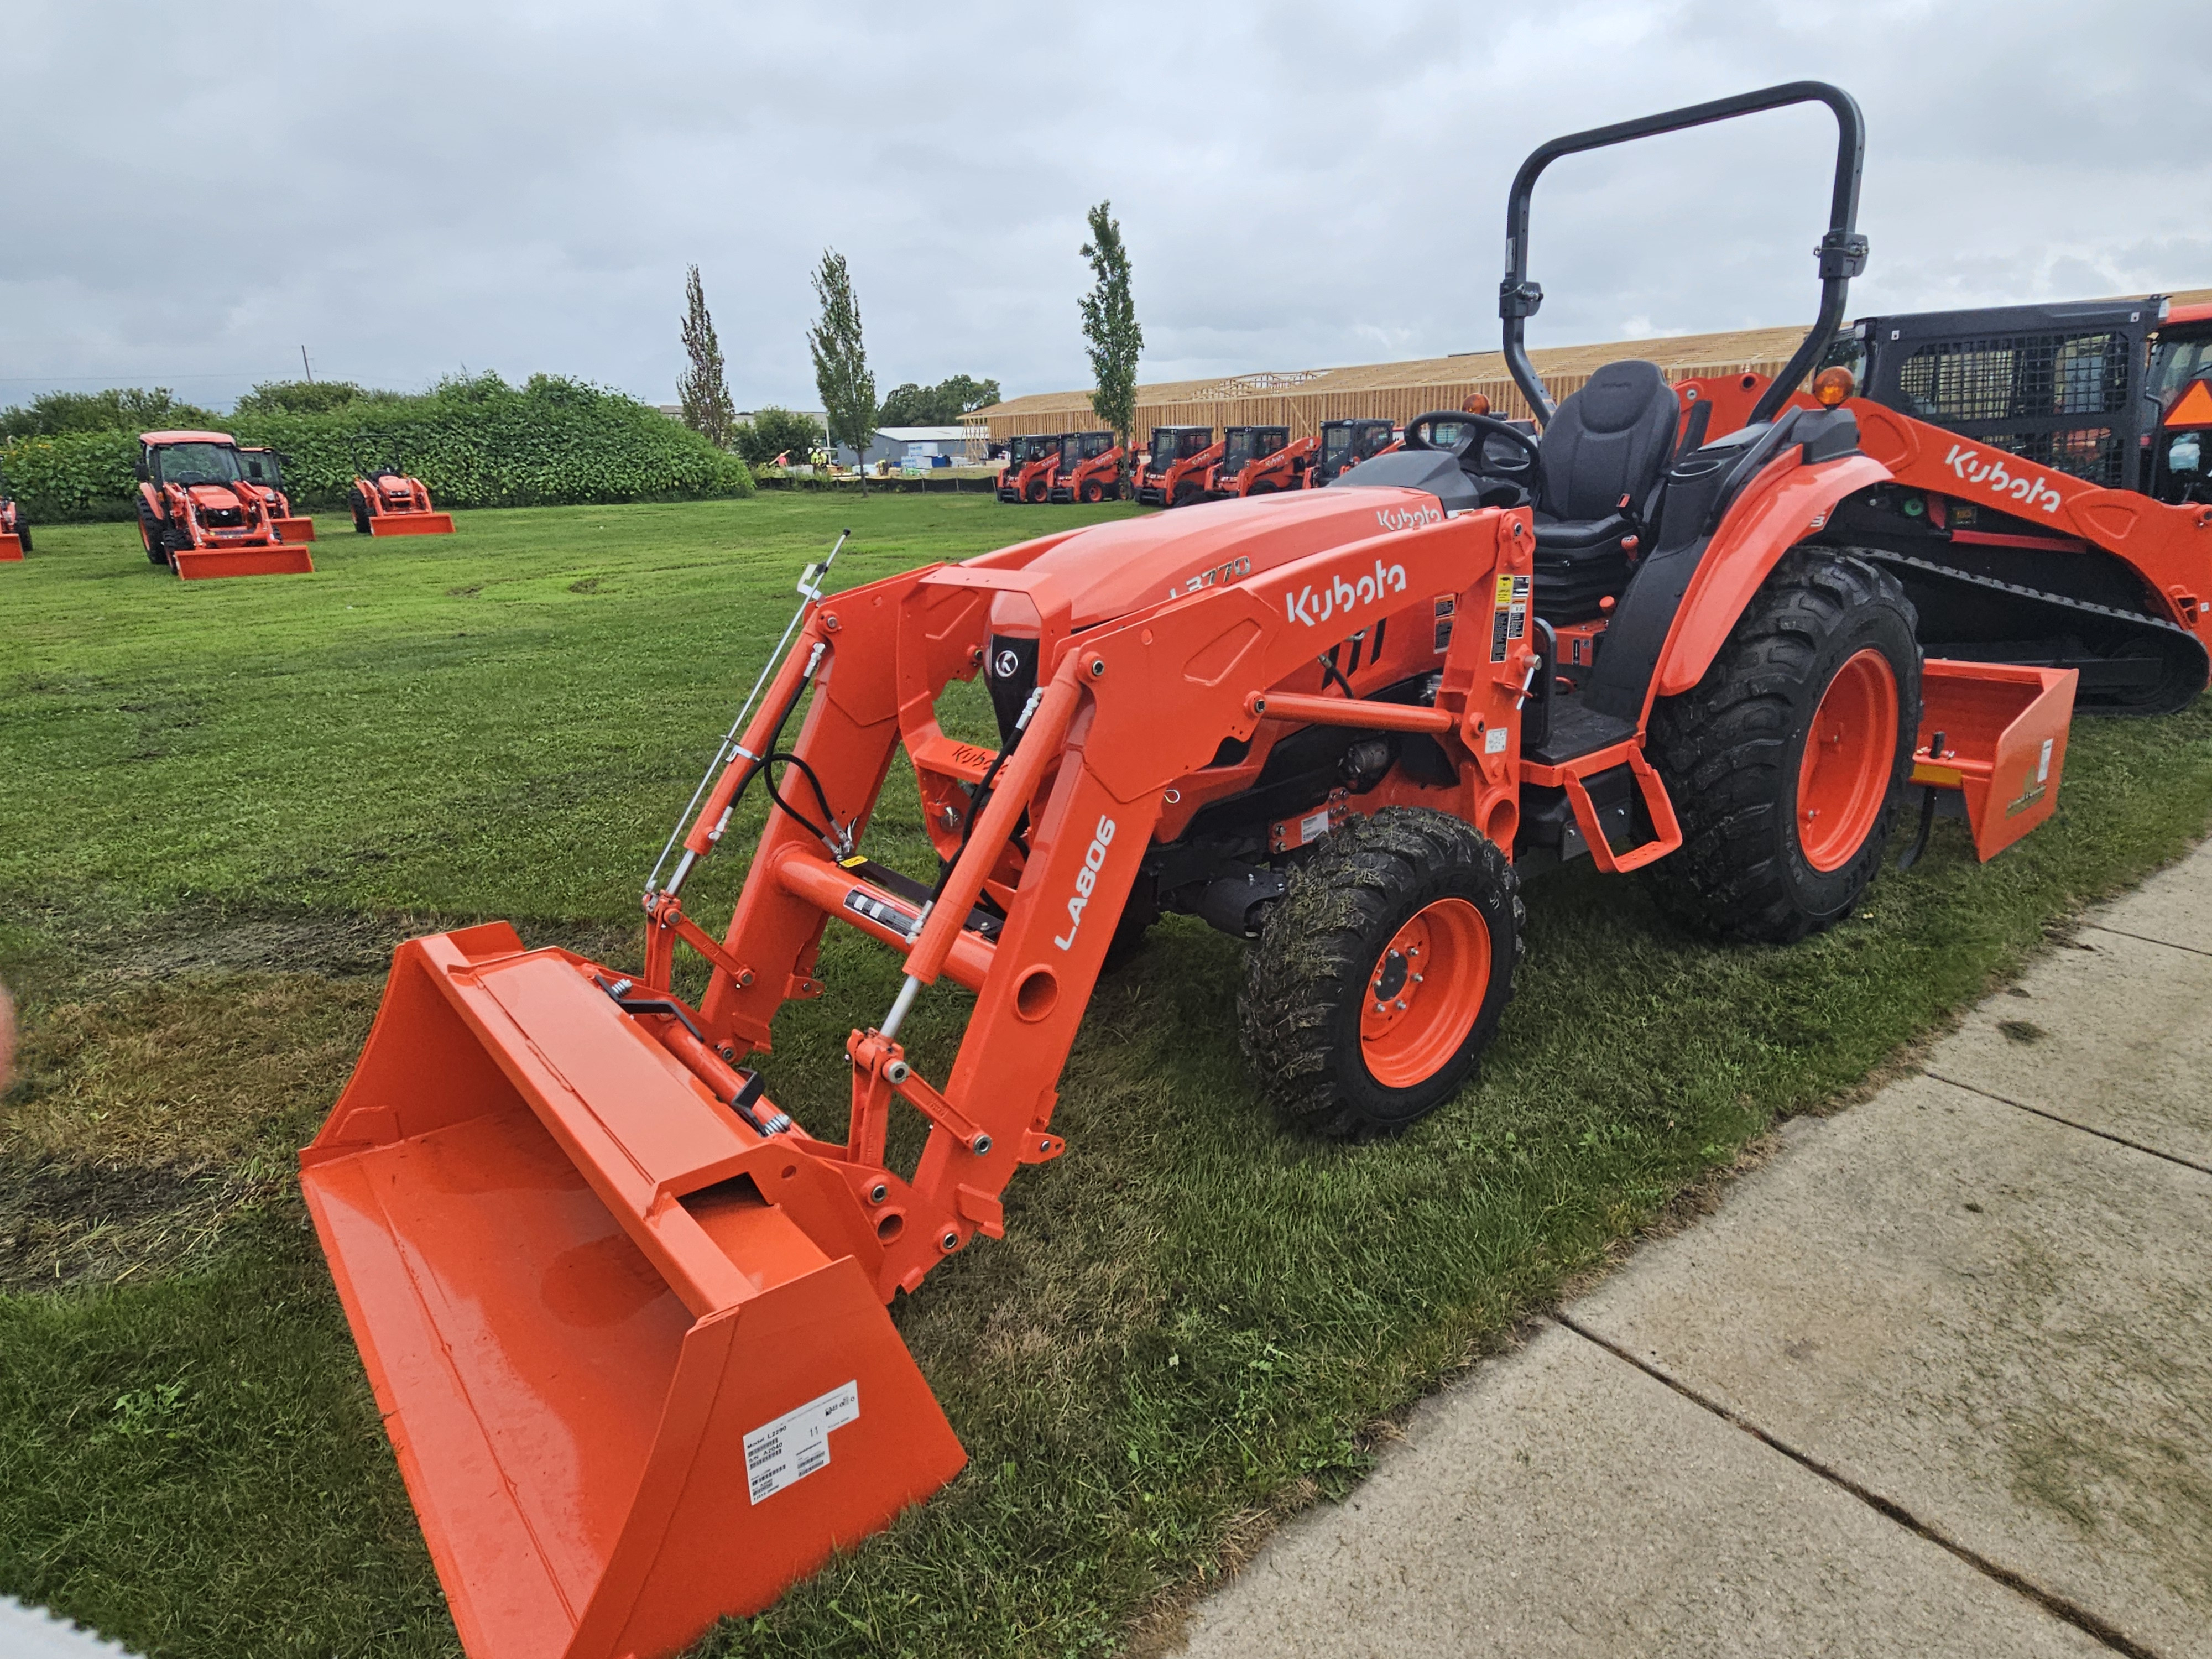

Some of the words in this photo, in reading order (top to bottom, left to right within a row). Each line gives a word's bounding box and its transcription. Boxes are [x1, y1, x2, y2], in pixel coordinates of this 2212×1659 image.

[1945, 444, 2061, 513] Kubota
[1376, 504, 1442, 531] Kubota
[1286, 559, 1406, 627] Kubota
[1054, 815, 1116, 951] LA806
